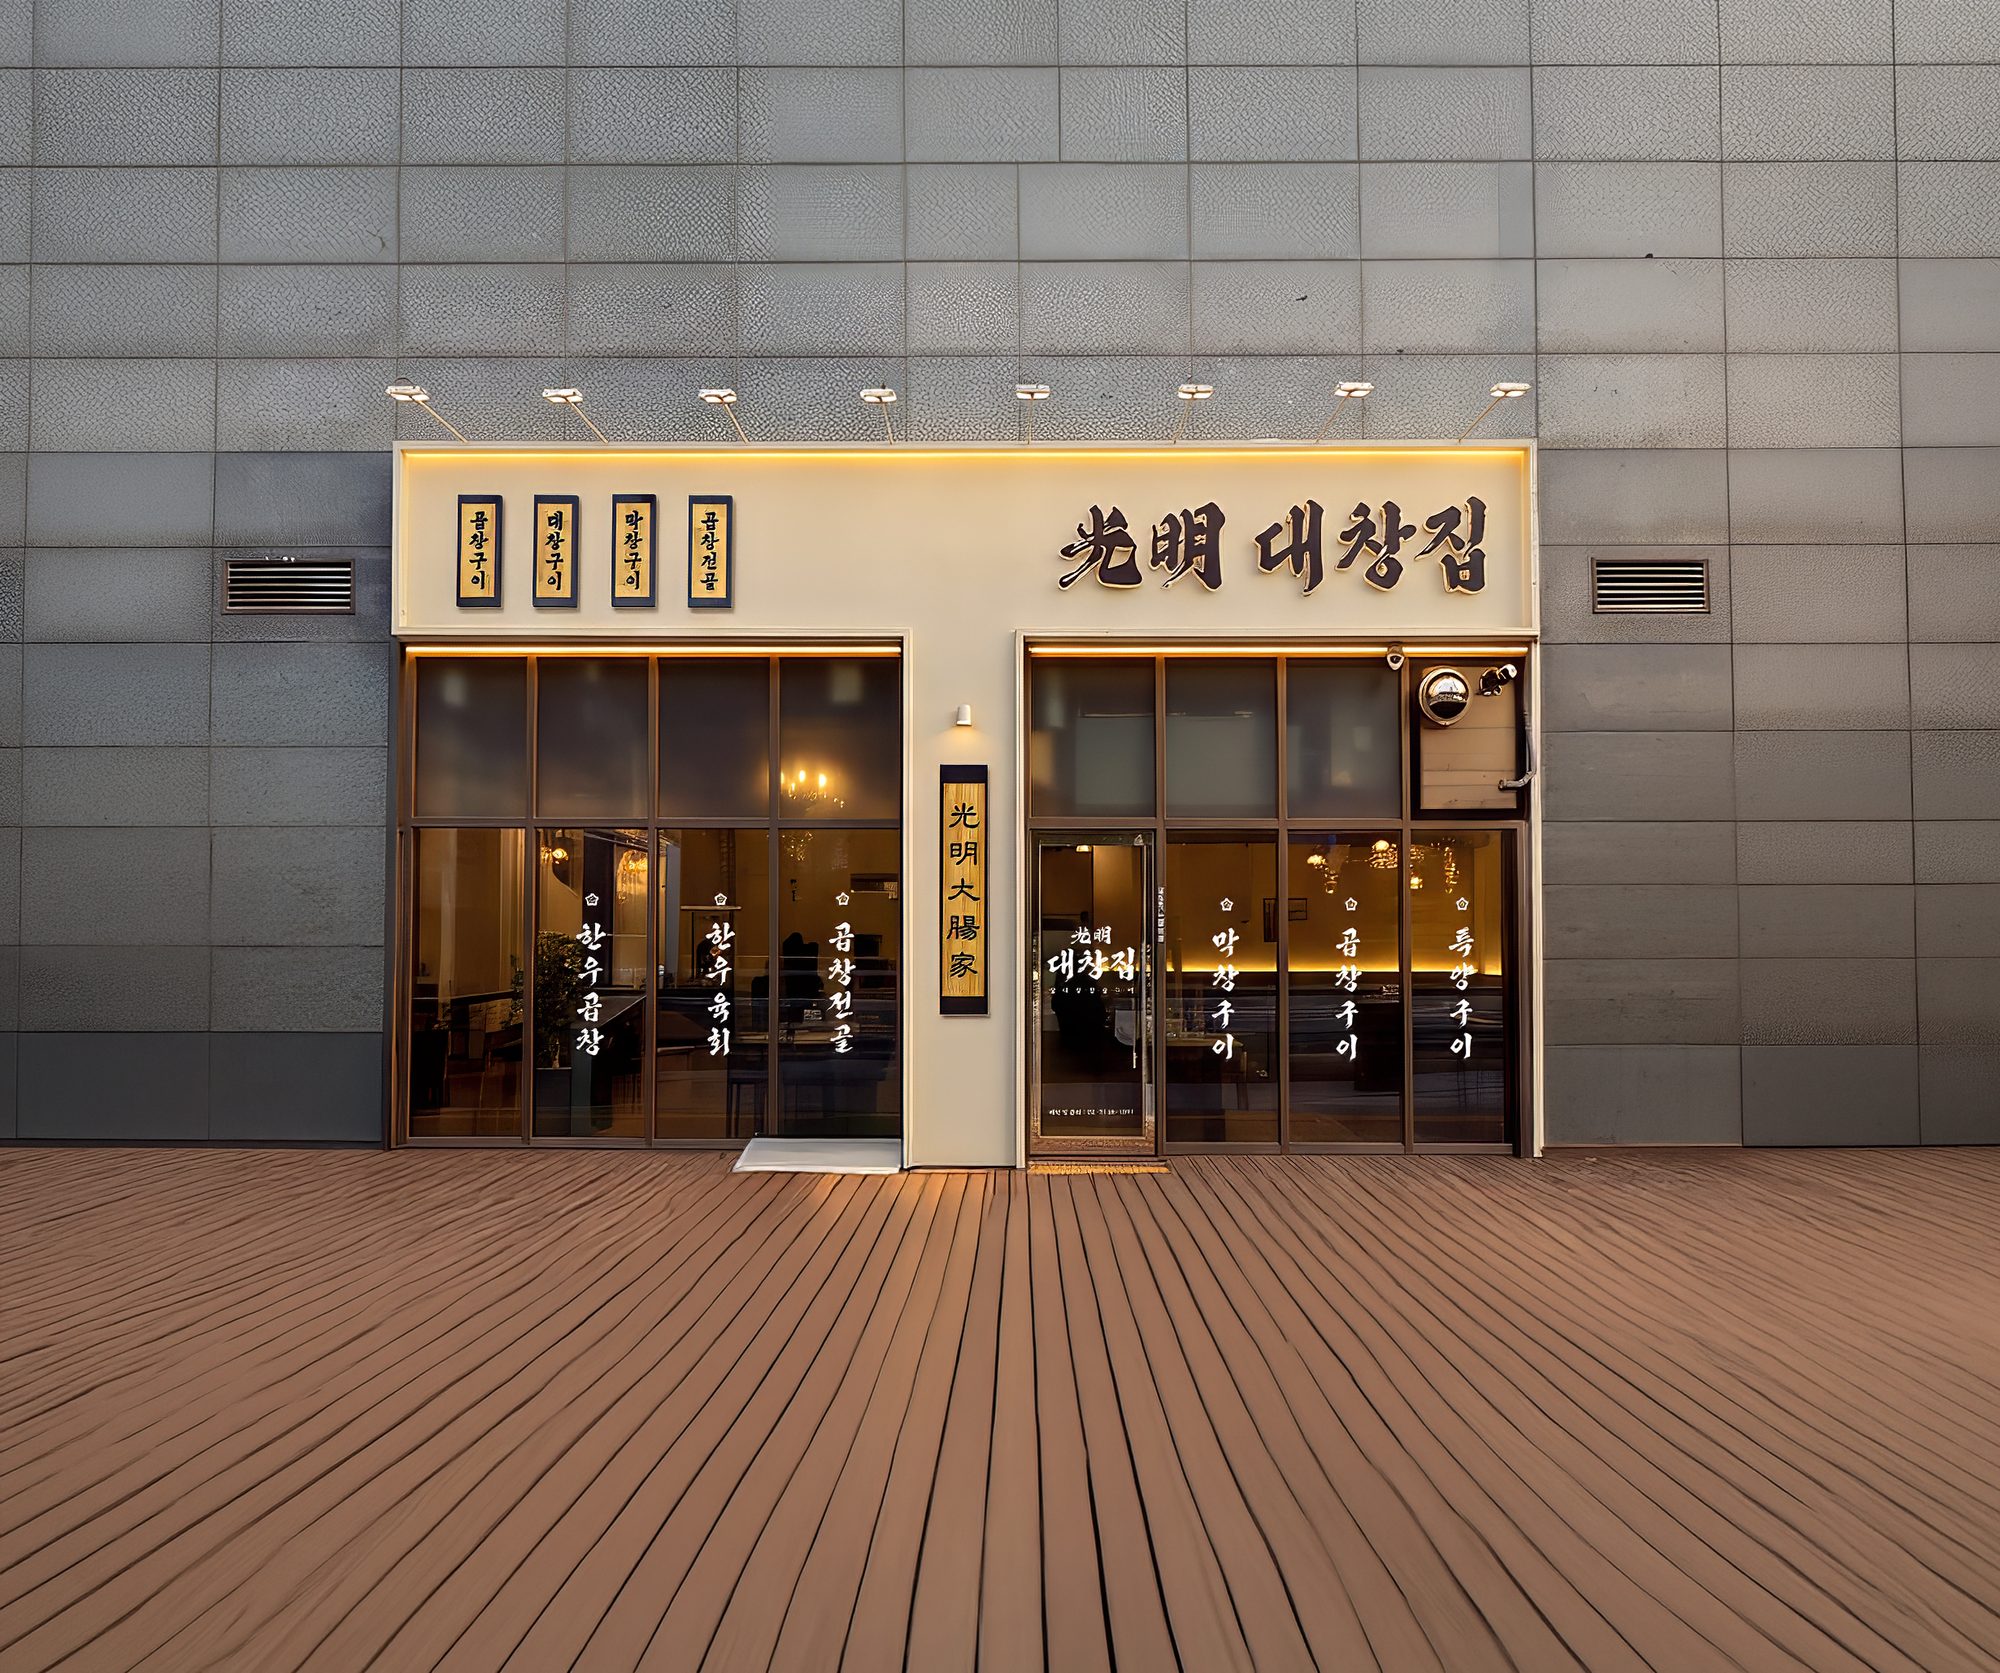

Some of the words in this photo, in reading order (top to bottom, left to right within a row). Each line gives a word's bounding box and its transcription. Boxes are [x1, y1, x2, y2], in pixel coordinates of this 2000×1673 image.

[1057, 501, 1227, 595] 光明
[1252, 495, 1488, 597] 대창집
[946, 802, 981, 978] 光明大腸家
[1070, 925, 1112, 945] 光明
[575, 922, 607, 1056] 한우곱창
[705, 922, 736, 1057] 한우육회
[827, 921, 856, 1054] 곱창전골
[1046, 946, 1135, 982] 대창집
[1211, 927, 1240, 1061] 막창구이
[1335, 927, 1363, 1062] 곱창구이
[1448, 926, 1477, 1061] 특양구이
